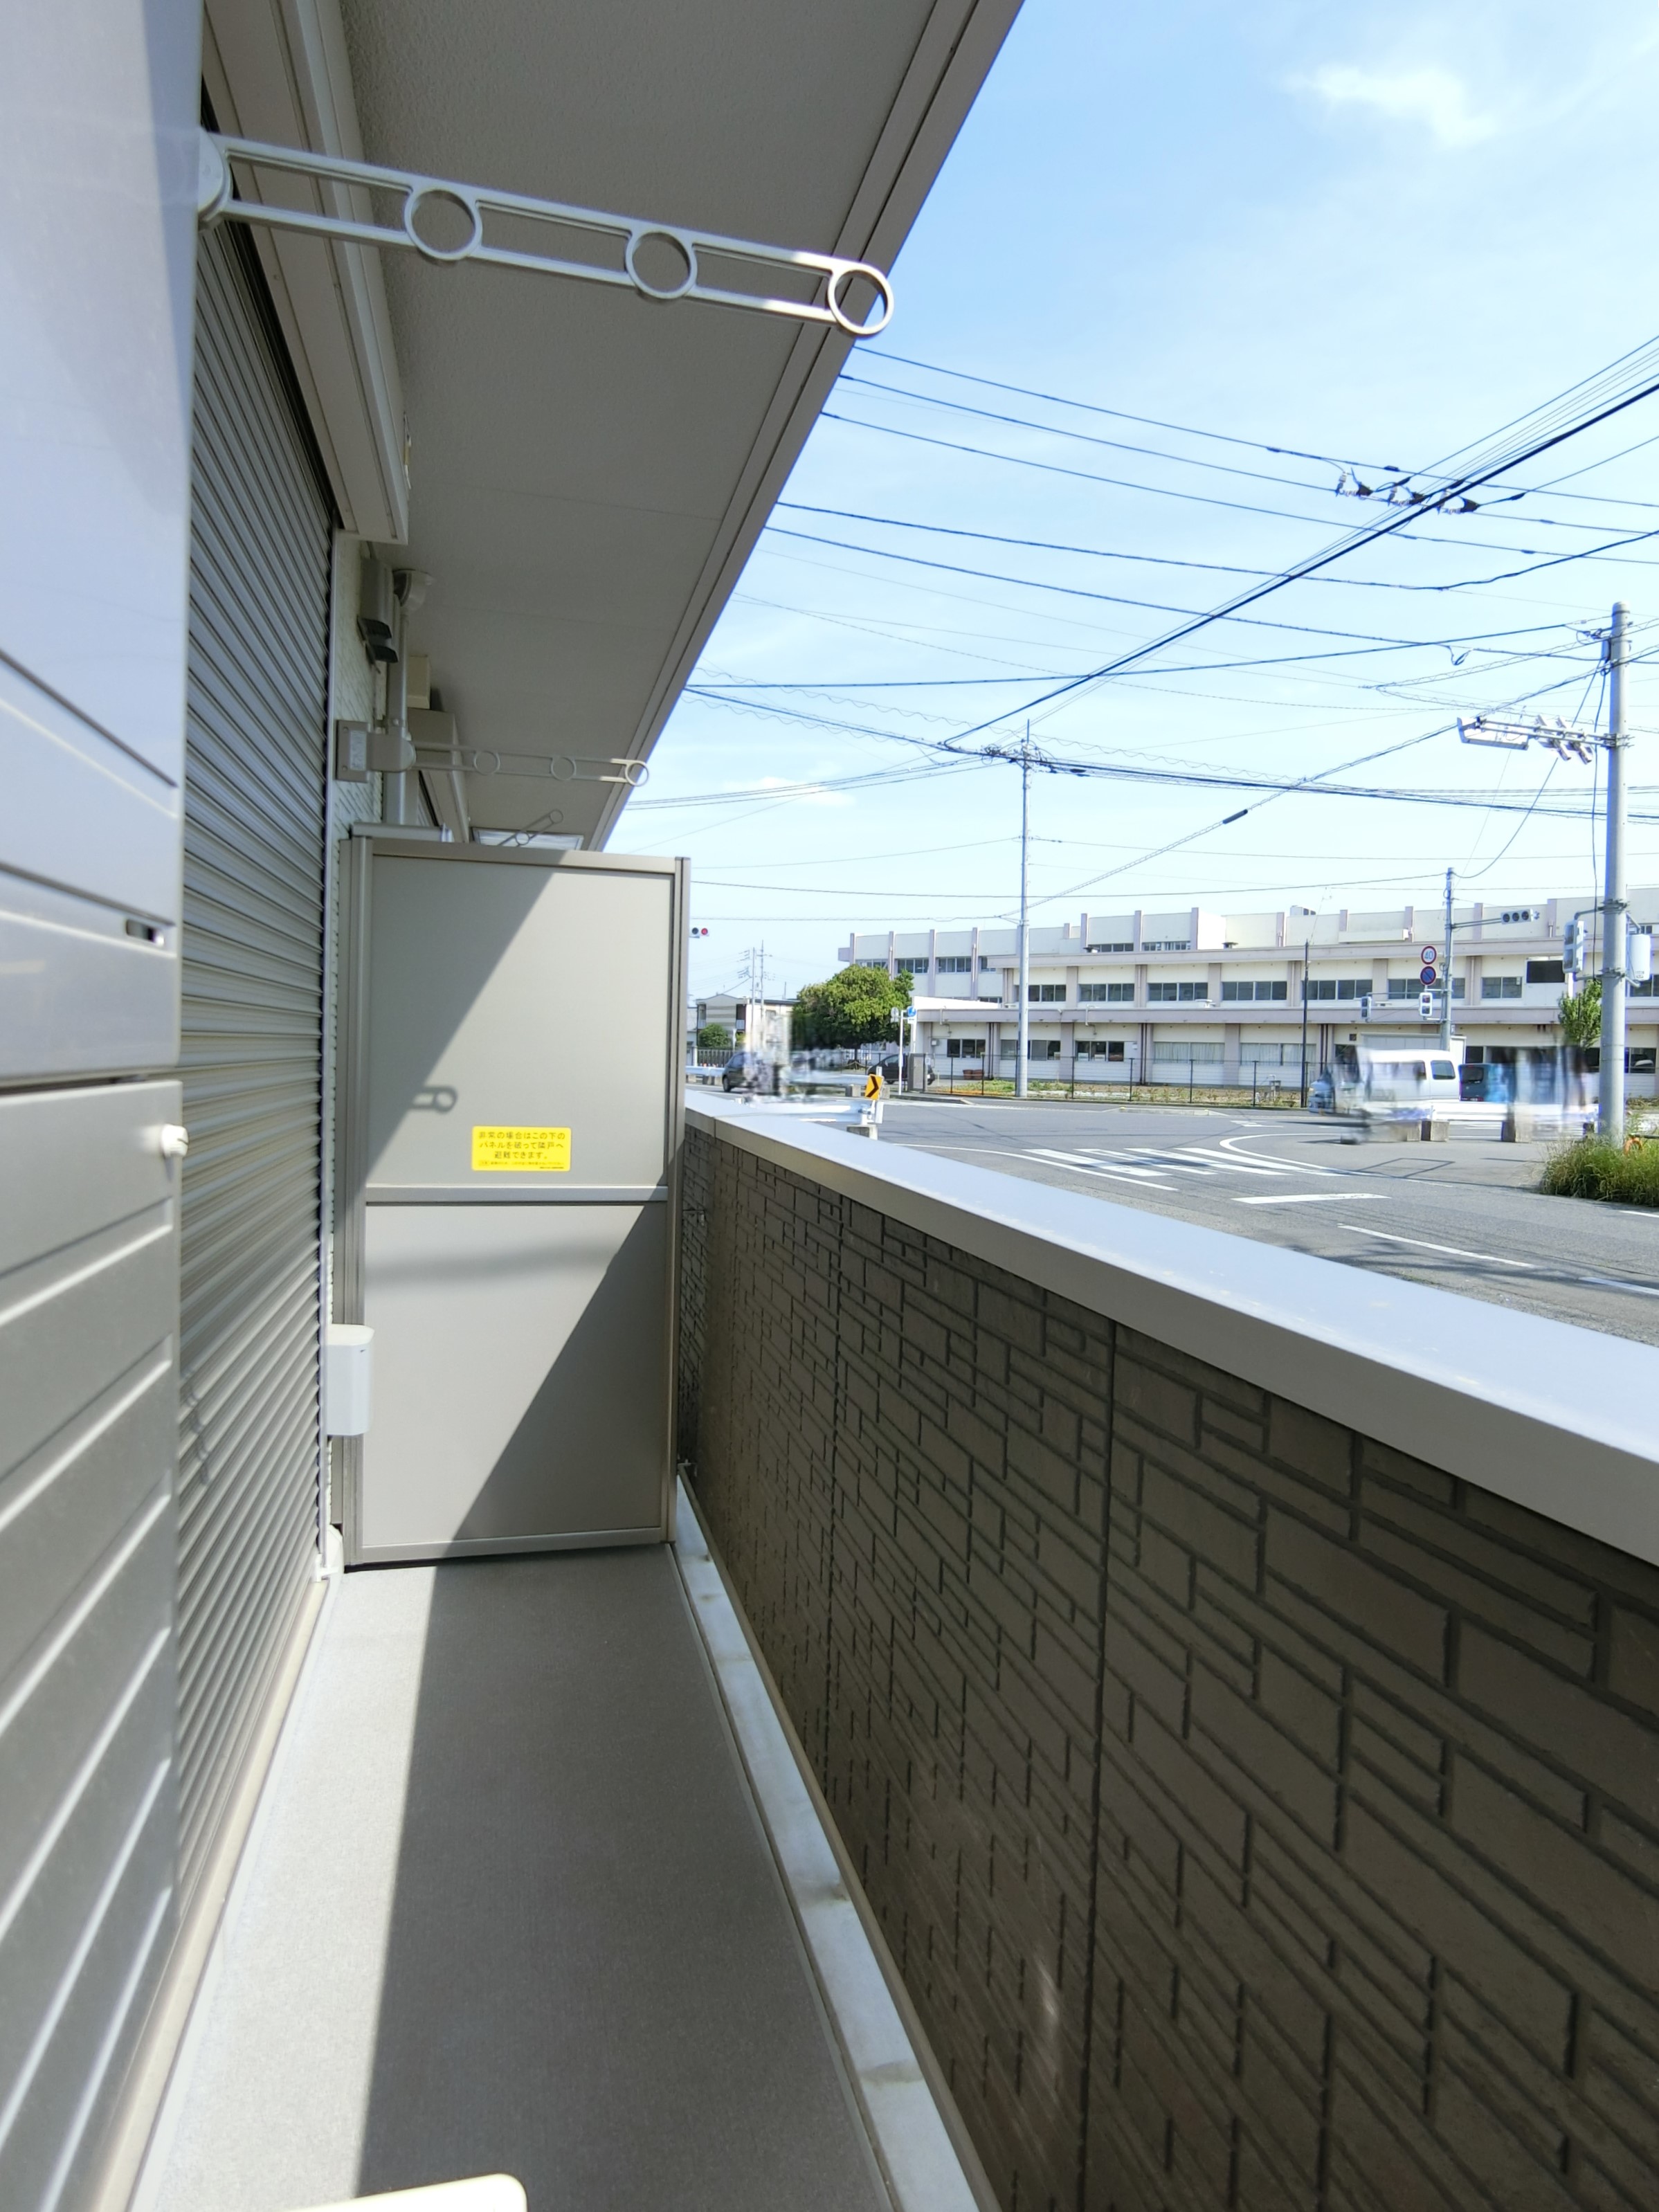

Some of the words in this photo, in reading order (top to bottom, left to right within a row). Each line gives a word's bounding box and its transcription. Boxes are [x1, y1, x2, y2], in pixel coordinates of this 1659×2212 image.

[1424, 951, 1433, 959] 40
[479, 1132, 565, 1140] 非常の場合はこの下の
[494, 1151, 547, 1159] 避難できます。
